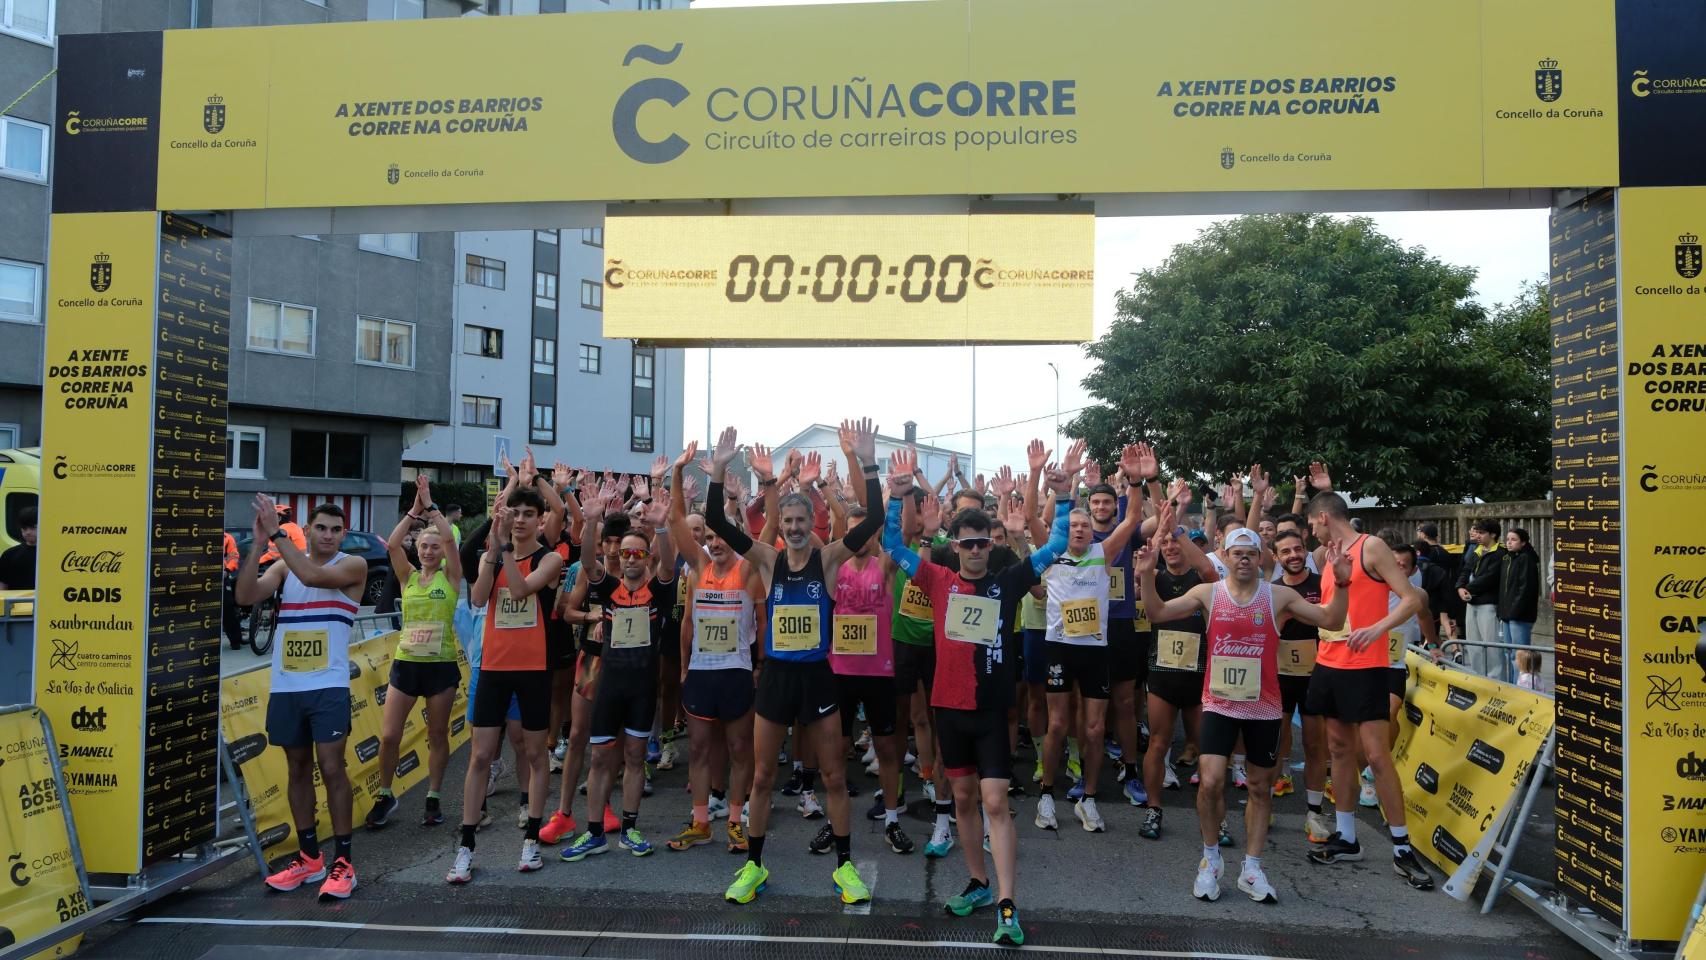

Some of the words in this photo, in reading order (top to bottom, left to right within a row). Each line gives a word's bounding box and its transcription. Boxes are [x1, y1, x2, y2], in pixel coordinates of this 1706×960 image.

[1157, 81, 1172, 97] A
[1177, 80, 1246, 96] XENTE
[1249, 78, 1296, 95] DOS
[1299, 76, 1396, 94] BARRIOS
[706, 76, 1076, 122] CORUÑACORRE
[1173, 100, 1246, 118] CORRE
[1250, 99, 1282, 116] NA
[1286, 94, 1380, 116] CORUÑA
[335, 103, 350, 118] A
[352, 101, 410, 118] XENTE
[414, 100, 454, 116] DOS
[458, 96, 543, 114] BARRIOS
[1496, 109, 1544, 119] Concello
[1547, 109, 1560, 118] da
[1563, 108, 1604, 118] Coruña
[82, 117, 148, 127] CORUÑACORRE
[348, 120, 410, 137] CORRE
[413, 120, 442, 135] NA
[445, 116, 528, 134] CORUÑA
[170, 140, 207, 149] Concello
[210, 140, 222, 148] da
[224, 138, 257, 148] Coruña
[704, 130, 796, 150] Circuíto
[802, 129, 834, 149] de
[840, 127, 946, 147] carreiras
[954, 126, 1078, 150] populares
[1240, 152, 1281, 162] Concello
[1283, 152, 1295, 162] da
[1297, 150, 1332, 162] Coruña
[404, 169, 440, 179] Concello
[444, 169, 454, 178] da
[456, 168, 484, 178] Coruña
[725, 254, 972, 304] 00:00:00
[1636, 285, 1682, 296] Concello
[1686, 285, 1700, 295] da
[58, 298, 96, 308] Concello
[98, 298, 108, 307] da
[111, 296, 143, 306] Coruña
[68, 350, 79, 362] A
[81, 349, 129, 362] XENTE
[1652, 344, 1665, 358] A
[49, 366, 80, 378] DOS
[82, 364, 147, 378] BARRIOS
[1628, 362, 1668, 376] DOS
[60, 382, 110, 394] CORRE
[111, 381, 134, 393] NA
[64, 394, 128, 409] CORUÑA
[70, 462, 136, 473] CORUÑACORRE
[62, 526, 127, 536] PATROCINAN
[60, 550, 126, 574] Coca-Cola
[63, 588, 122, 603] GADIS
[502, 598, 528, 614] 1502
[49, 614, 134, 631] sanbrandan
[962, 606, 983, 626] 22
[1066, 606, 1096, 624] 3036
[626, 618, 632, 633] 7
[705, 625, 728, 640] 779
[779, 616, 811, 634] 3016
[842, 625, 867, 640] 3311
[287, 640, 322, 657] 3320
[1172, 640, 1184, 656] 13
[1291, 650, 1299, 663] 5
[1224, 668, 1247, 686] 107
[84, 682, 95, 695] de
[97, 681, 134, 695] Galicia
[71, 705, 107, 730] dxt
[70, 746, 113, 758] MANELL
[71, 773, 118, 786] YAMAHA
